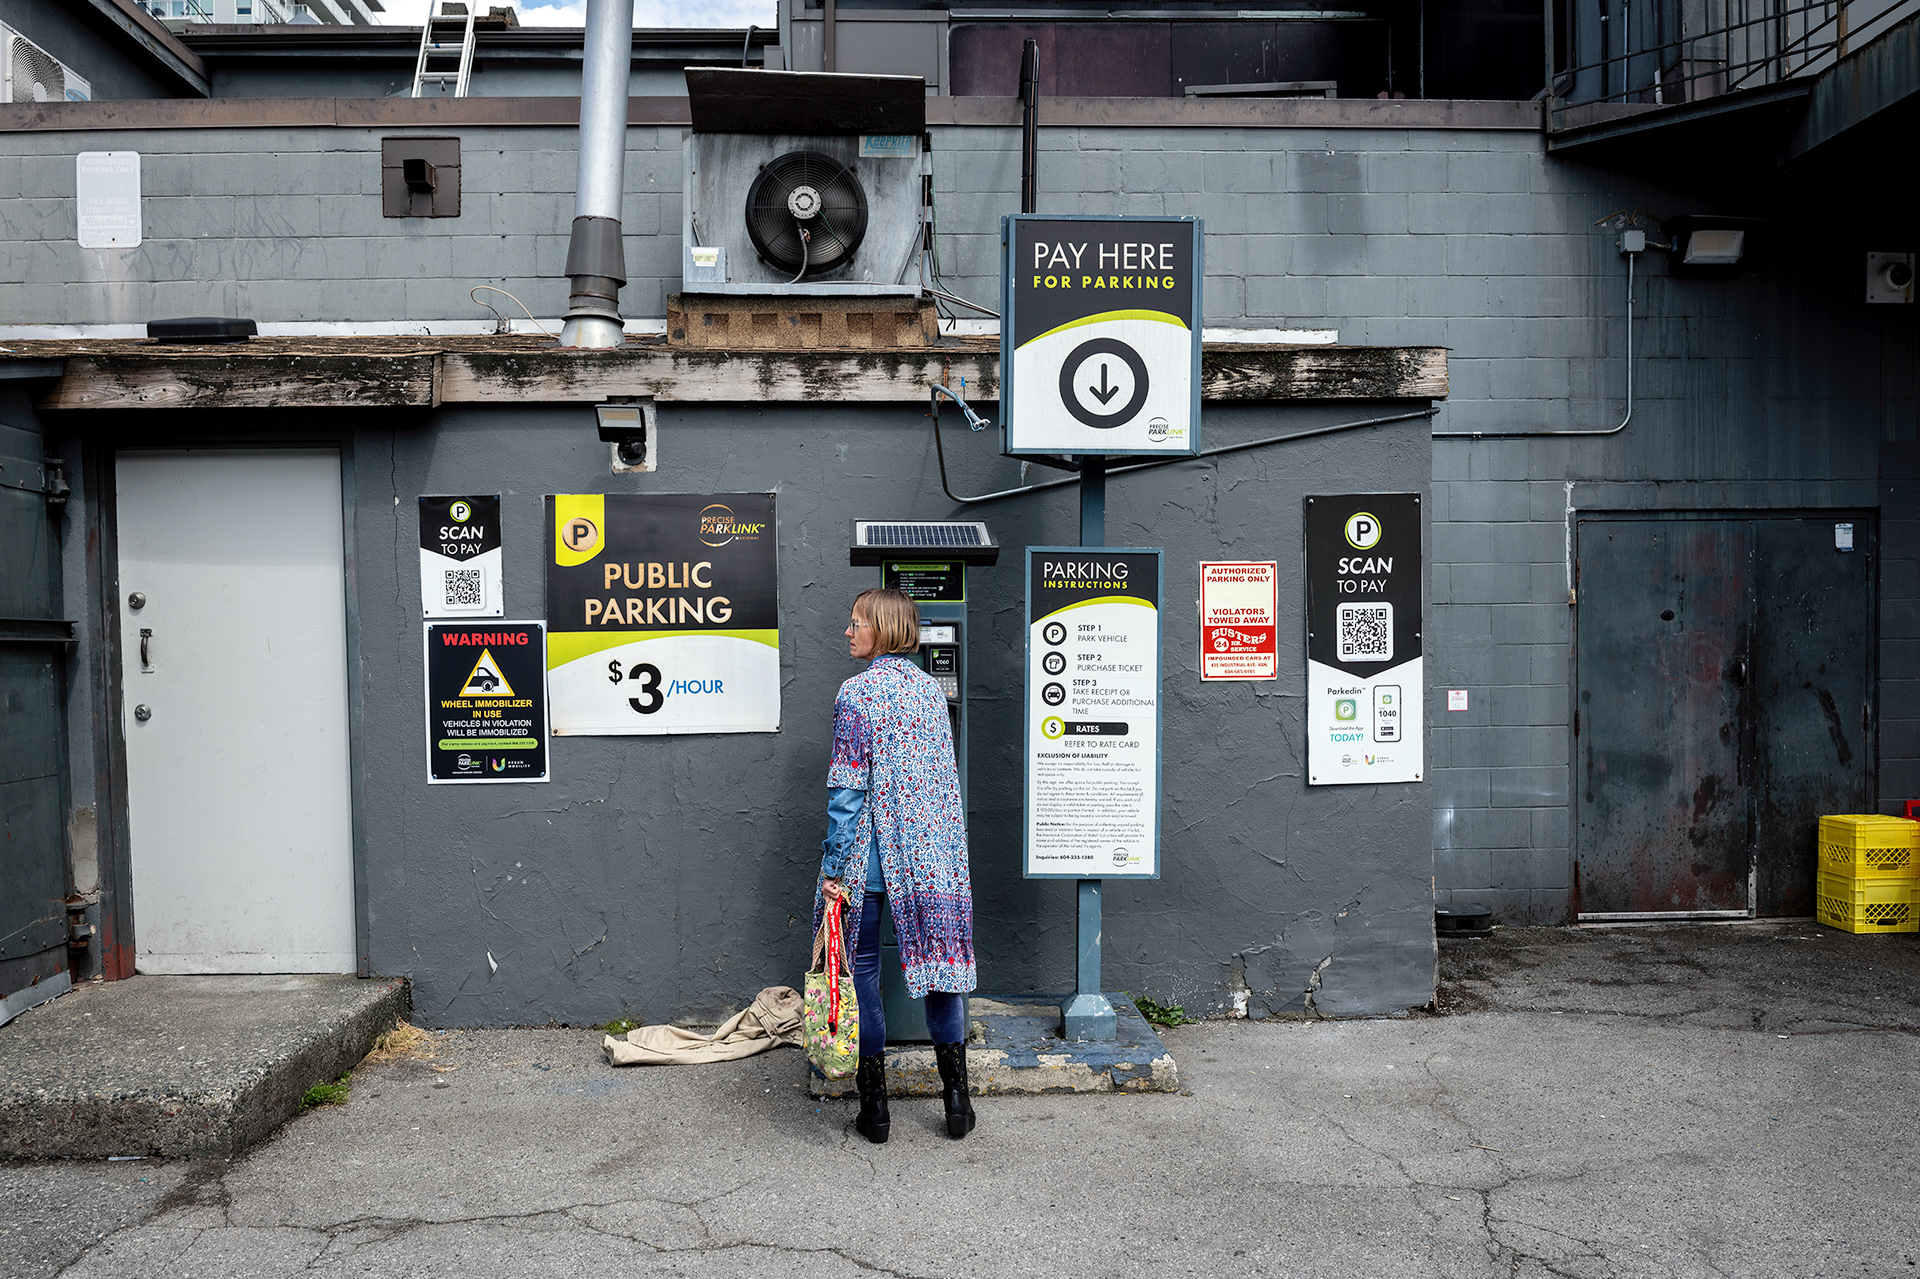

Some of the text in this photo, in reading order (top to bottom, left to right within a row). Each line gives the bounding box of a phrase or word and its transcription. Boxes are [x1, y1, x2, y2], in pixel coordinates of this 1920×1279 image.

[1034, 242, 1174, 270] PAY HERE
[1033, 275, 1176, 290] FOR PARKING
[456, 506, 465, 517] P
[439, 525, 484, 540] SCAN
[573, 524, 589, 546] P
[1357, 521, 1371, 541] P
[441, 543, 482, 554] TO PAY
[1043, 562, 1129, 579] PARKING
[1337, 557, 1393, 574] SCAN
[604, 561, 712, 589] PUBLIC
[1044, 580, 1128, 589] INSTRUCTIONS
[1336, 579, 1387, 594] TO PAY
[585, 596, 733, 625] PARKING
[442, 633, 529, 646] WARNING
[1051, 630, 1059, 638] P
[1211, 628, 1267, 644] BUSTERS
[628, 662, 664, 714] 3
[667, 679, 724, 698] /HOUR
[441, 699, 533, 708] WHEEL IMMOBILIZER
[484, 710, 502, 718] USE
[1330, 733, 1364, 742] TODAY!
